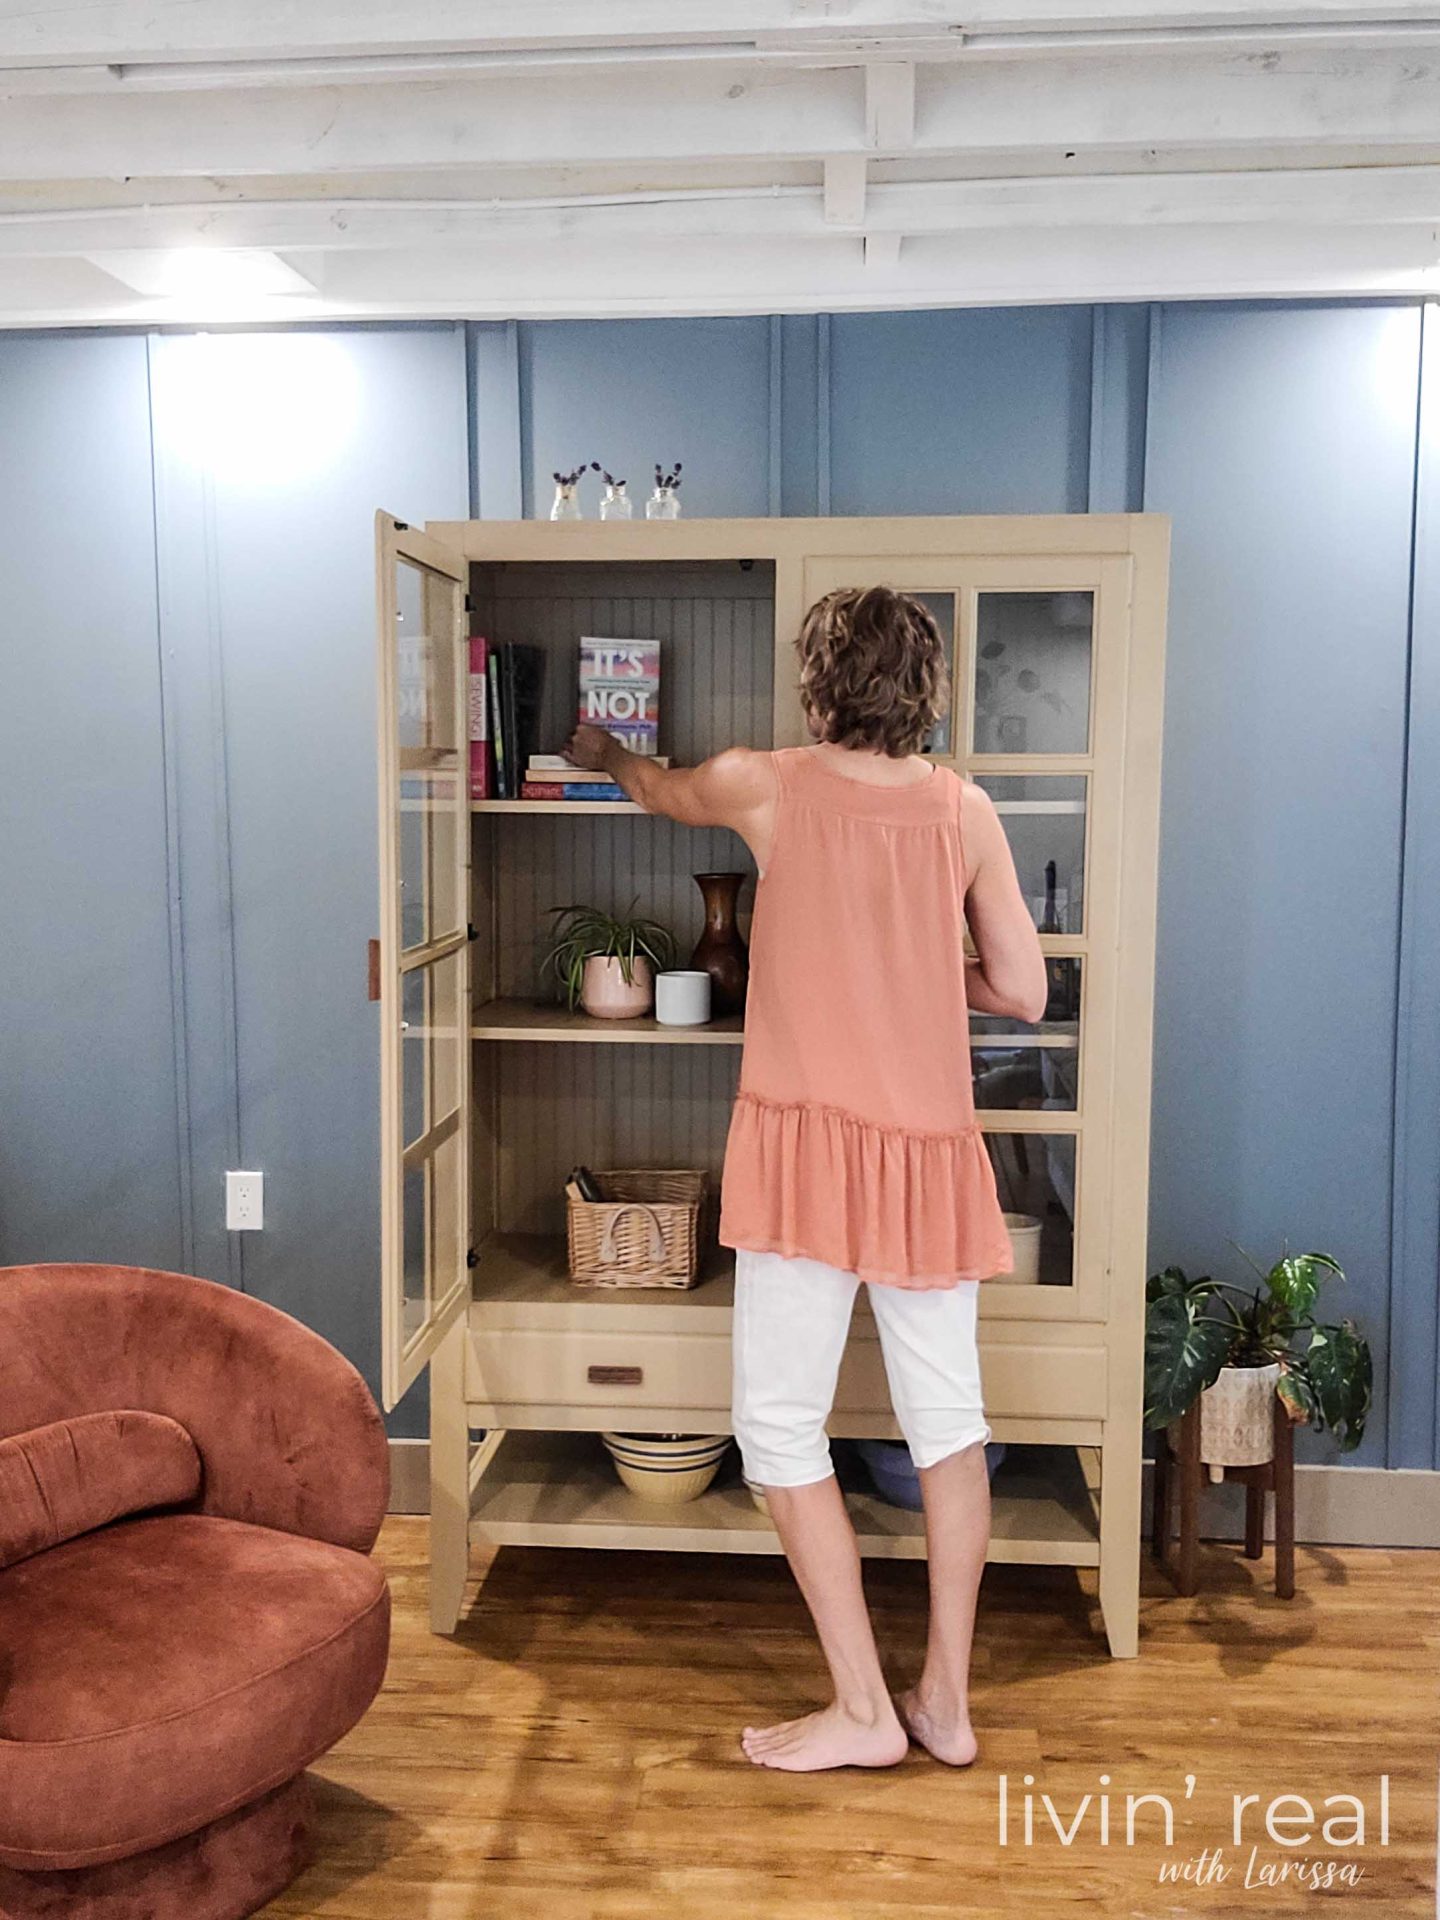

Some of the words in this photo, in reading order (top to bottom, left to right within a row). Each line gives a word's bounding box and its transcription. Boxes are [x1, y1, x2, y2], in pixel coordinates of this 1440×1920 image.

[593, 648, 644, 677] IT'S
[470, 680, 483, 734] SEWING
[587, 690, 650, 719] NOT
